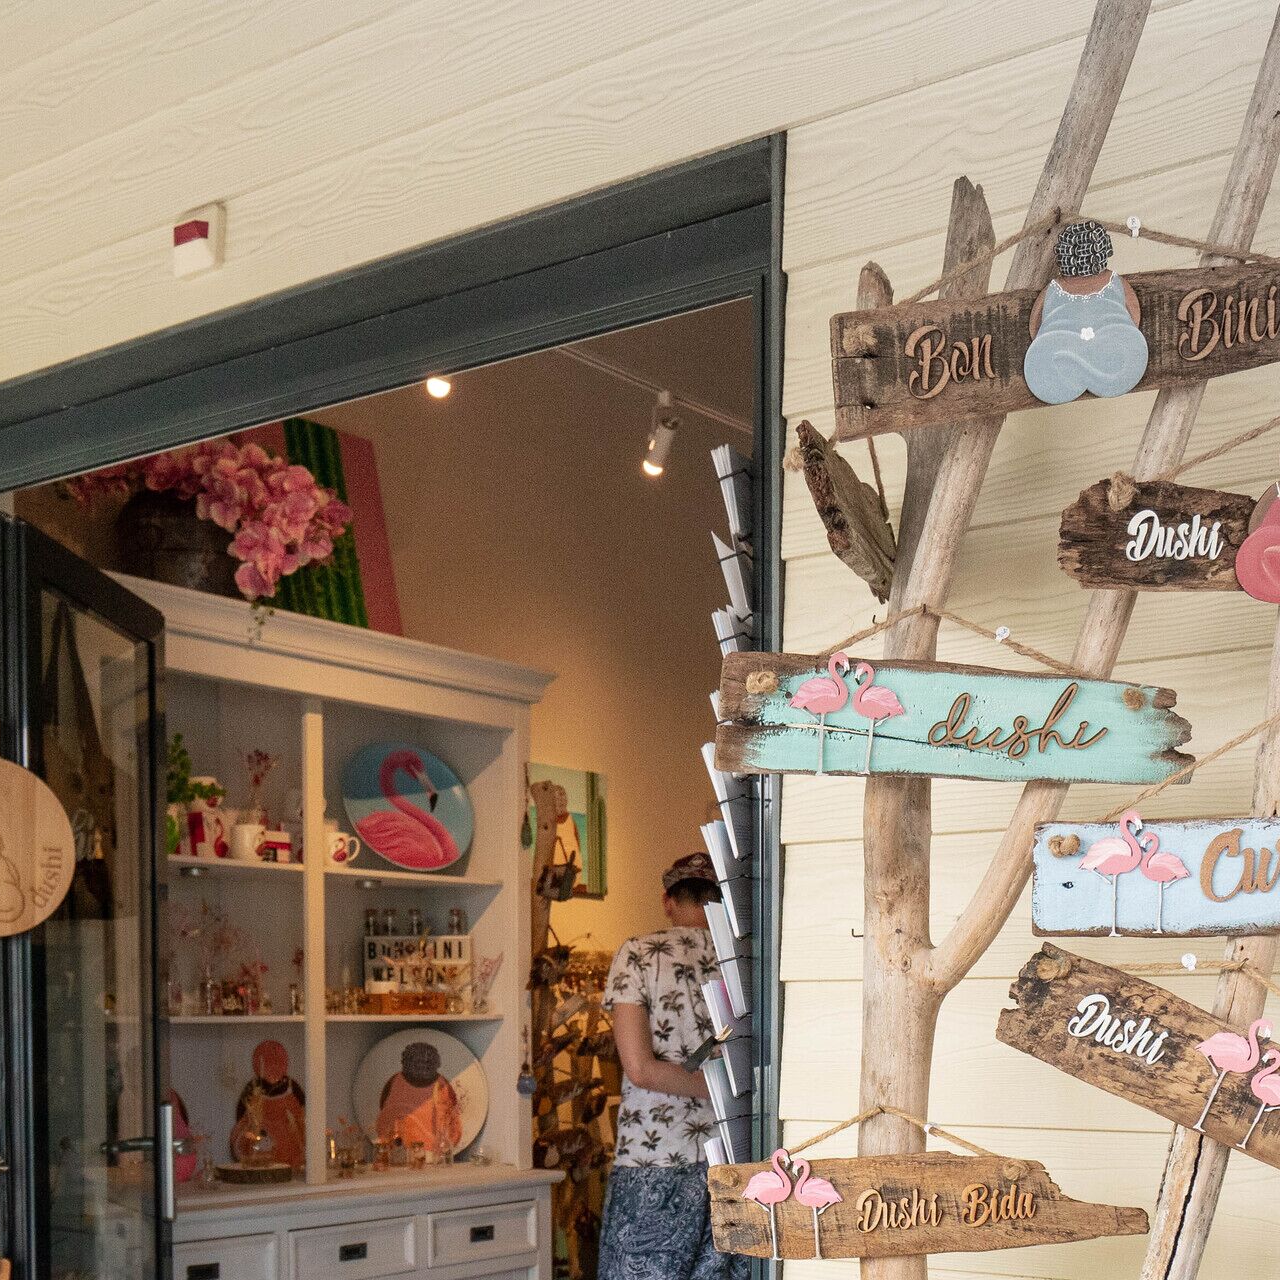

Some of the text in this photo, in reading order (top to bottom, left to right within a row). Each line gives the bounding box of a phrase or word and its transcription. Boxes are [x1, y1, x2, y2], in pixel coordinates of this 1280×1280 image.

[905, 325, 997, 400] Bon
[1126, 509, 1224, 562] Dushi
[928, 682, 1108, 759] dushi
[1067, 993, 1171, 1066] Dushi
[856, 1182, 1036, 1233] Dushi Bida
